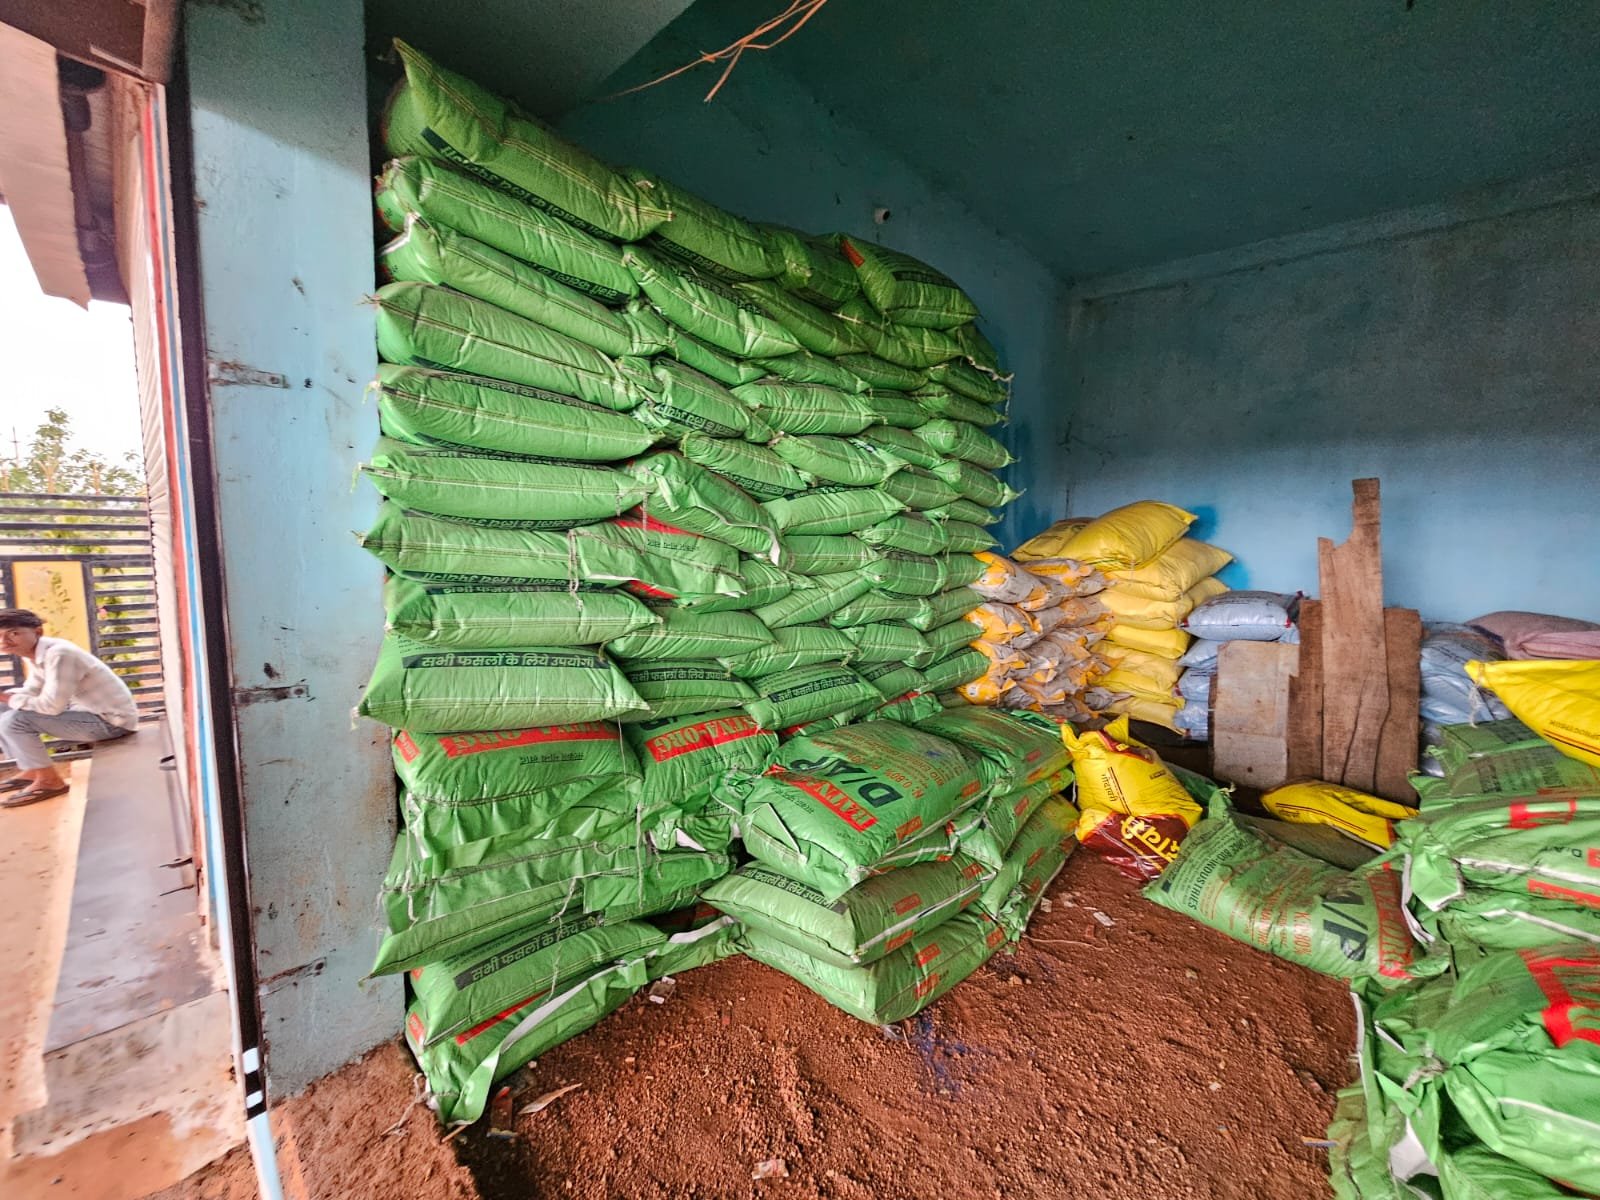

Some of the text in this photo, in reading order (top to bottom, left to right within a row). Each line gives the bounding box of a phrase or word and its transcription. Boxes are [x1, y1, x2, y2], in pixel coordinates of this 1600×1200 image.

[422, 652, 594, 668] सभी फसलों के लिये उपयोगी
[785, 879, 806, 897] लिये
[469, 957, 502, 981] सभी
[499, 938, 542, 966] फसलों
[540, 932, 555, 947] के
